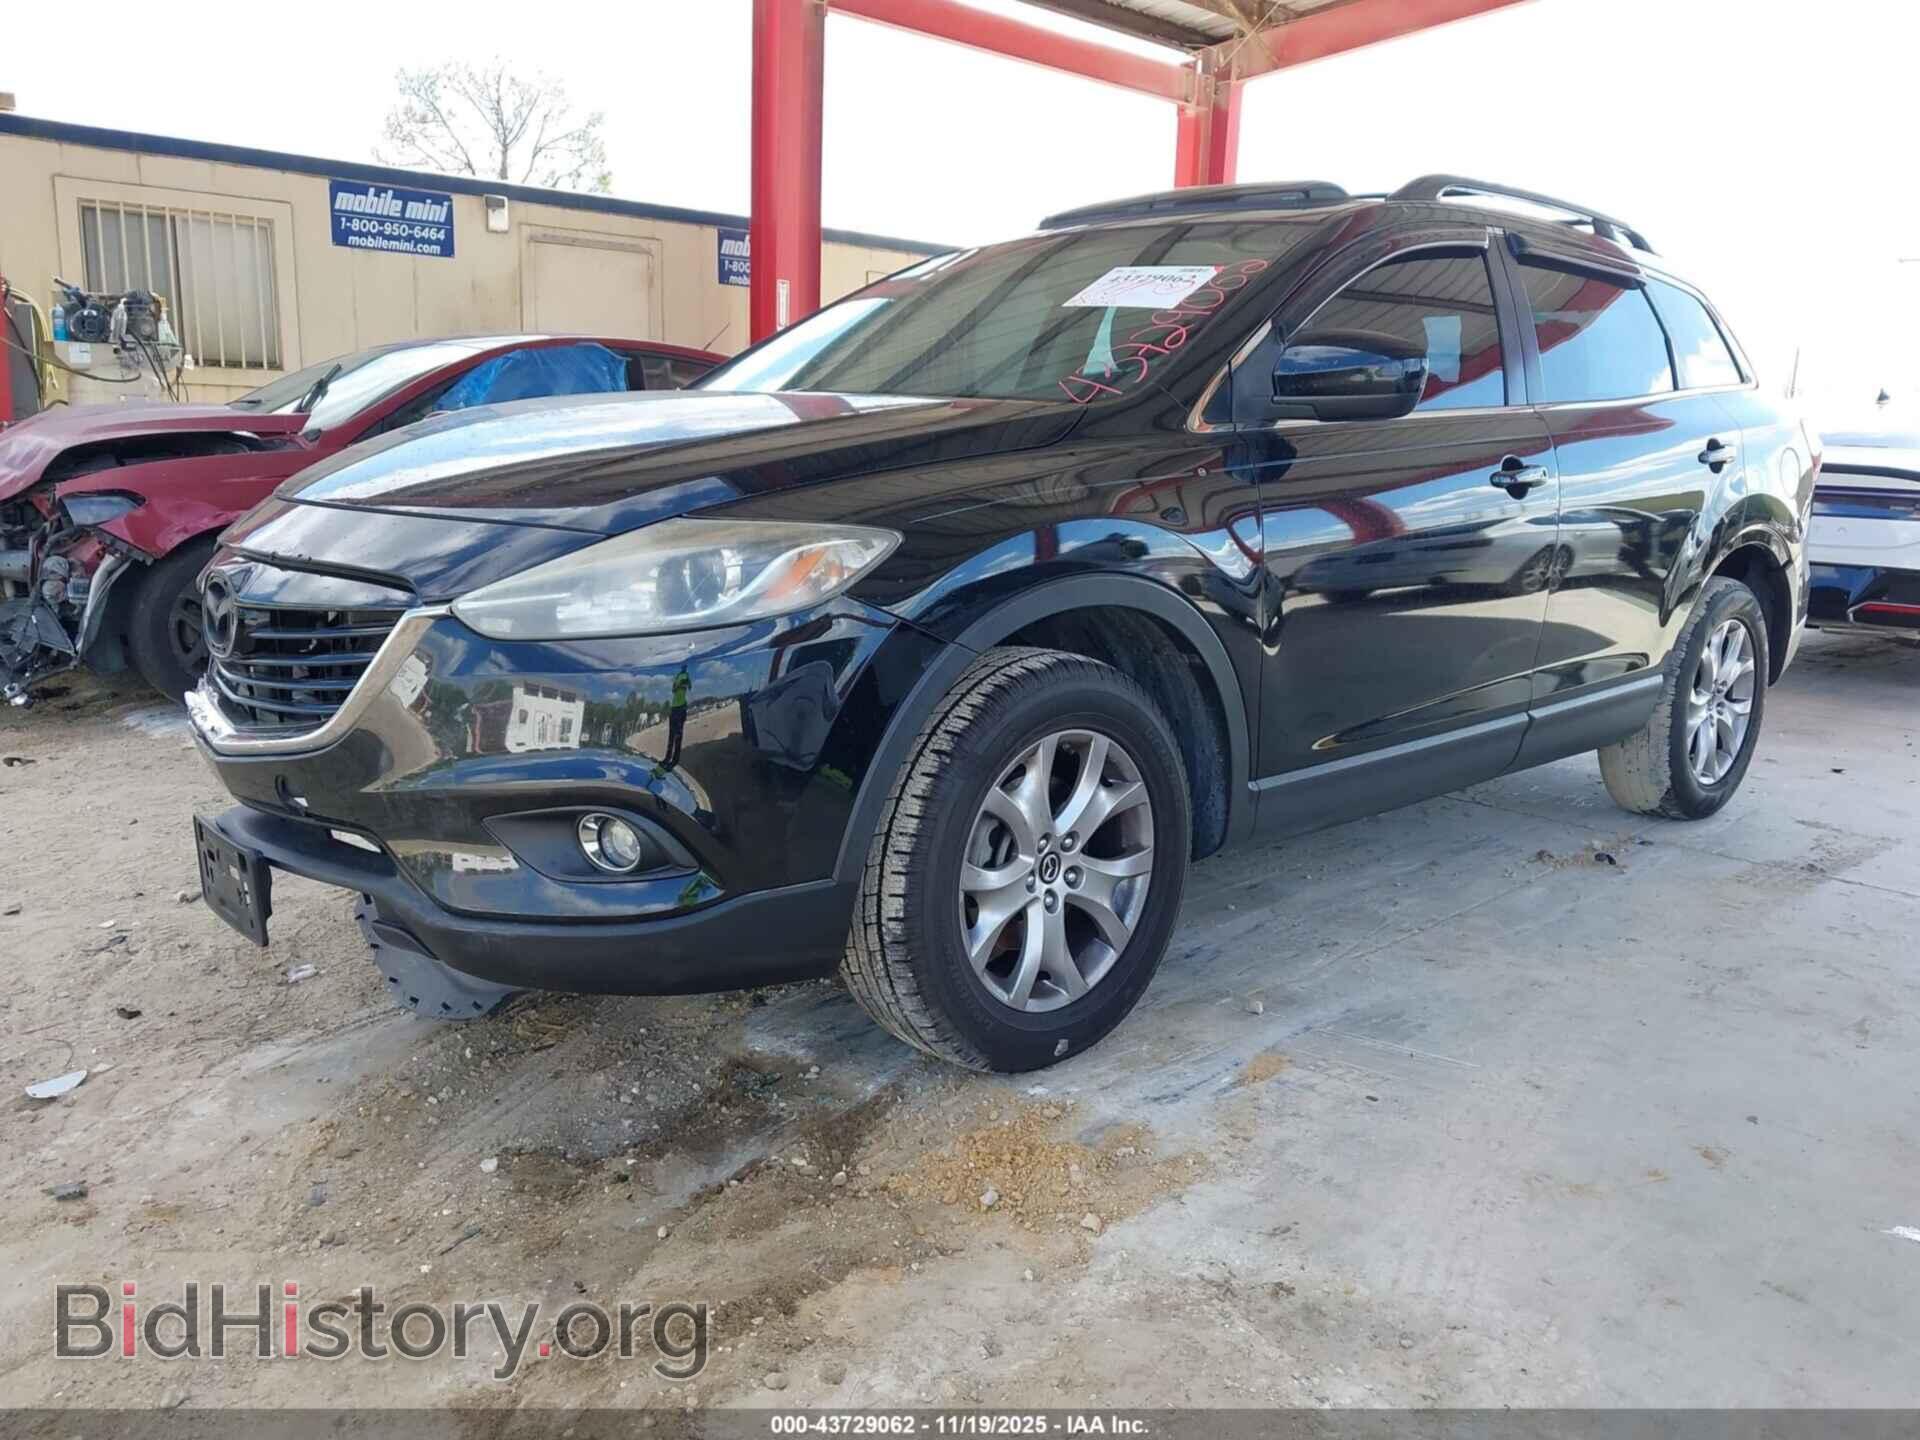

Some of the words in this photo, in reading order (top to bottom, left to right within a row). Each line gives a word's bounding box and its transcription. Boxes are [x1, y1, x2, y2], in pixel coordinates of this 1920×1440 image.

[334, 187, 402, 217] mobile
[404, 199, 449, 223] mini
[340, 217, 446, 240] 1-800-950-6464
[347, 235, 441, 255] mobilemini.com
